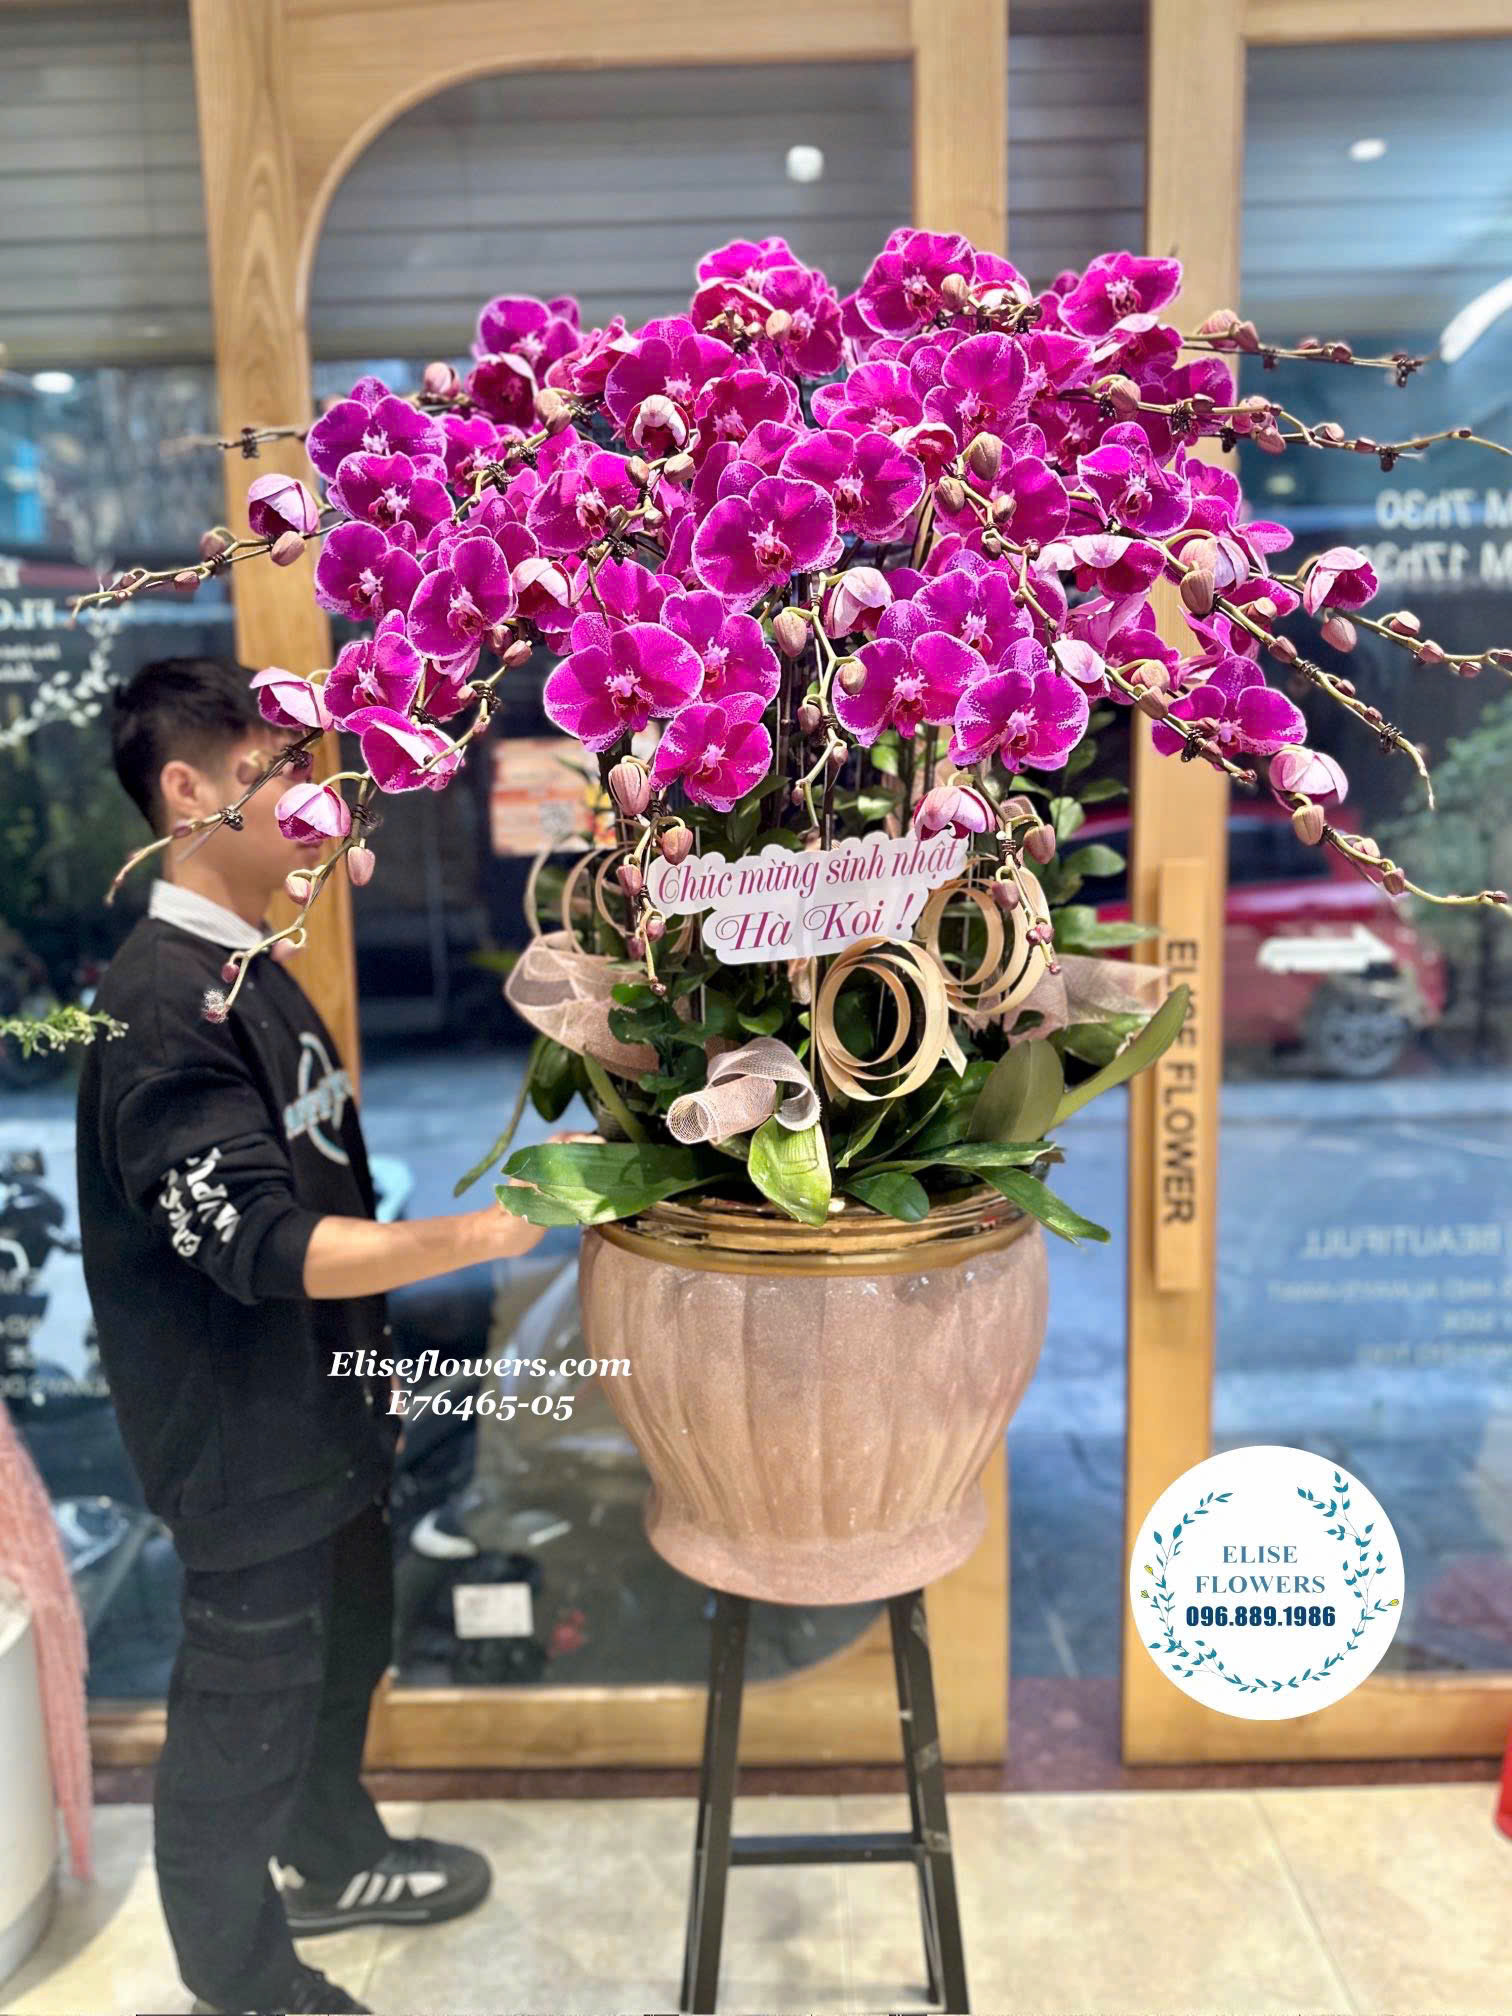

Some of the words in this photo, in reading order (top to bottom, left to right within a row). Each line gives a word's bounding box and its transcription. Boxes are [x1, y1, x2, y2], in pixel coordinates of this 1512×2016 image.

[658, 864, 733, 904] Chúc
[738, 859, 819, 899] mừng
[825, 843, 886, 885] sinh
[891, 838, 958, 880] nhật
[715, 911, 793, 951] Hà
[802, 900, 885, 941] Koi
[1163, 1061, 1196, 1225] FLOWER
